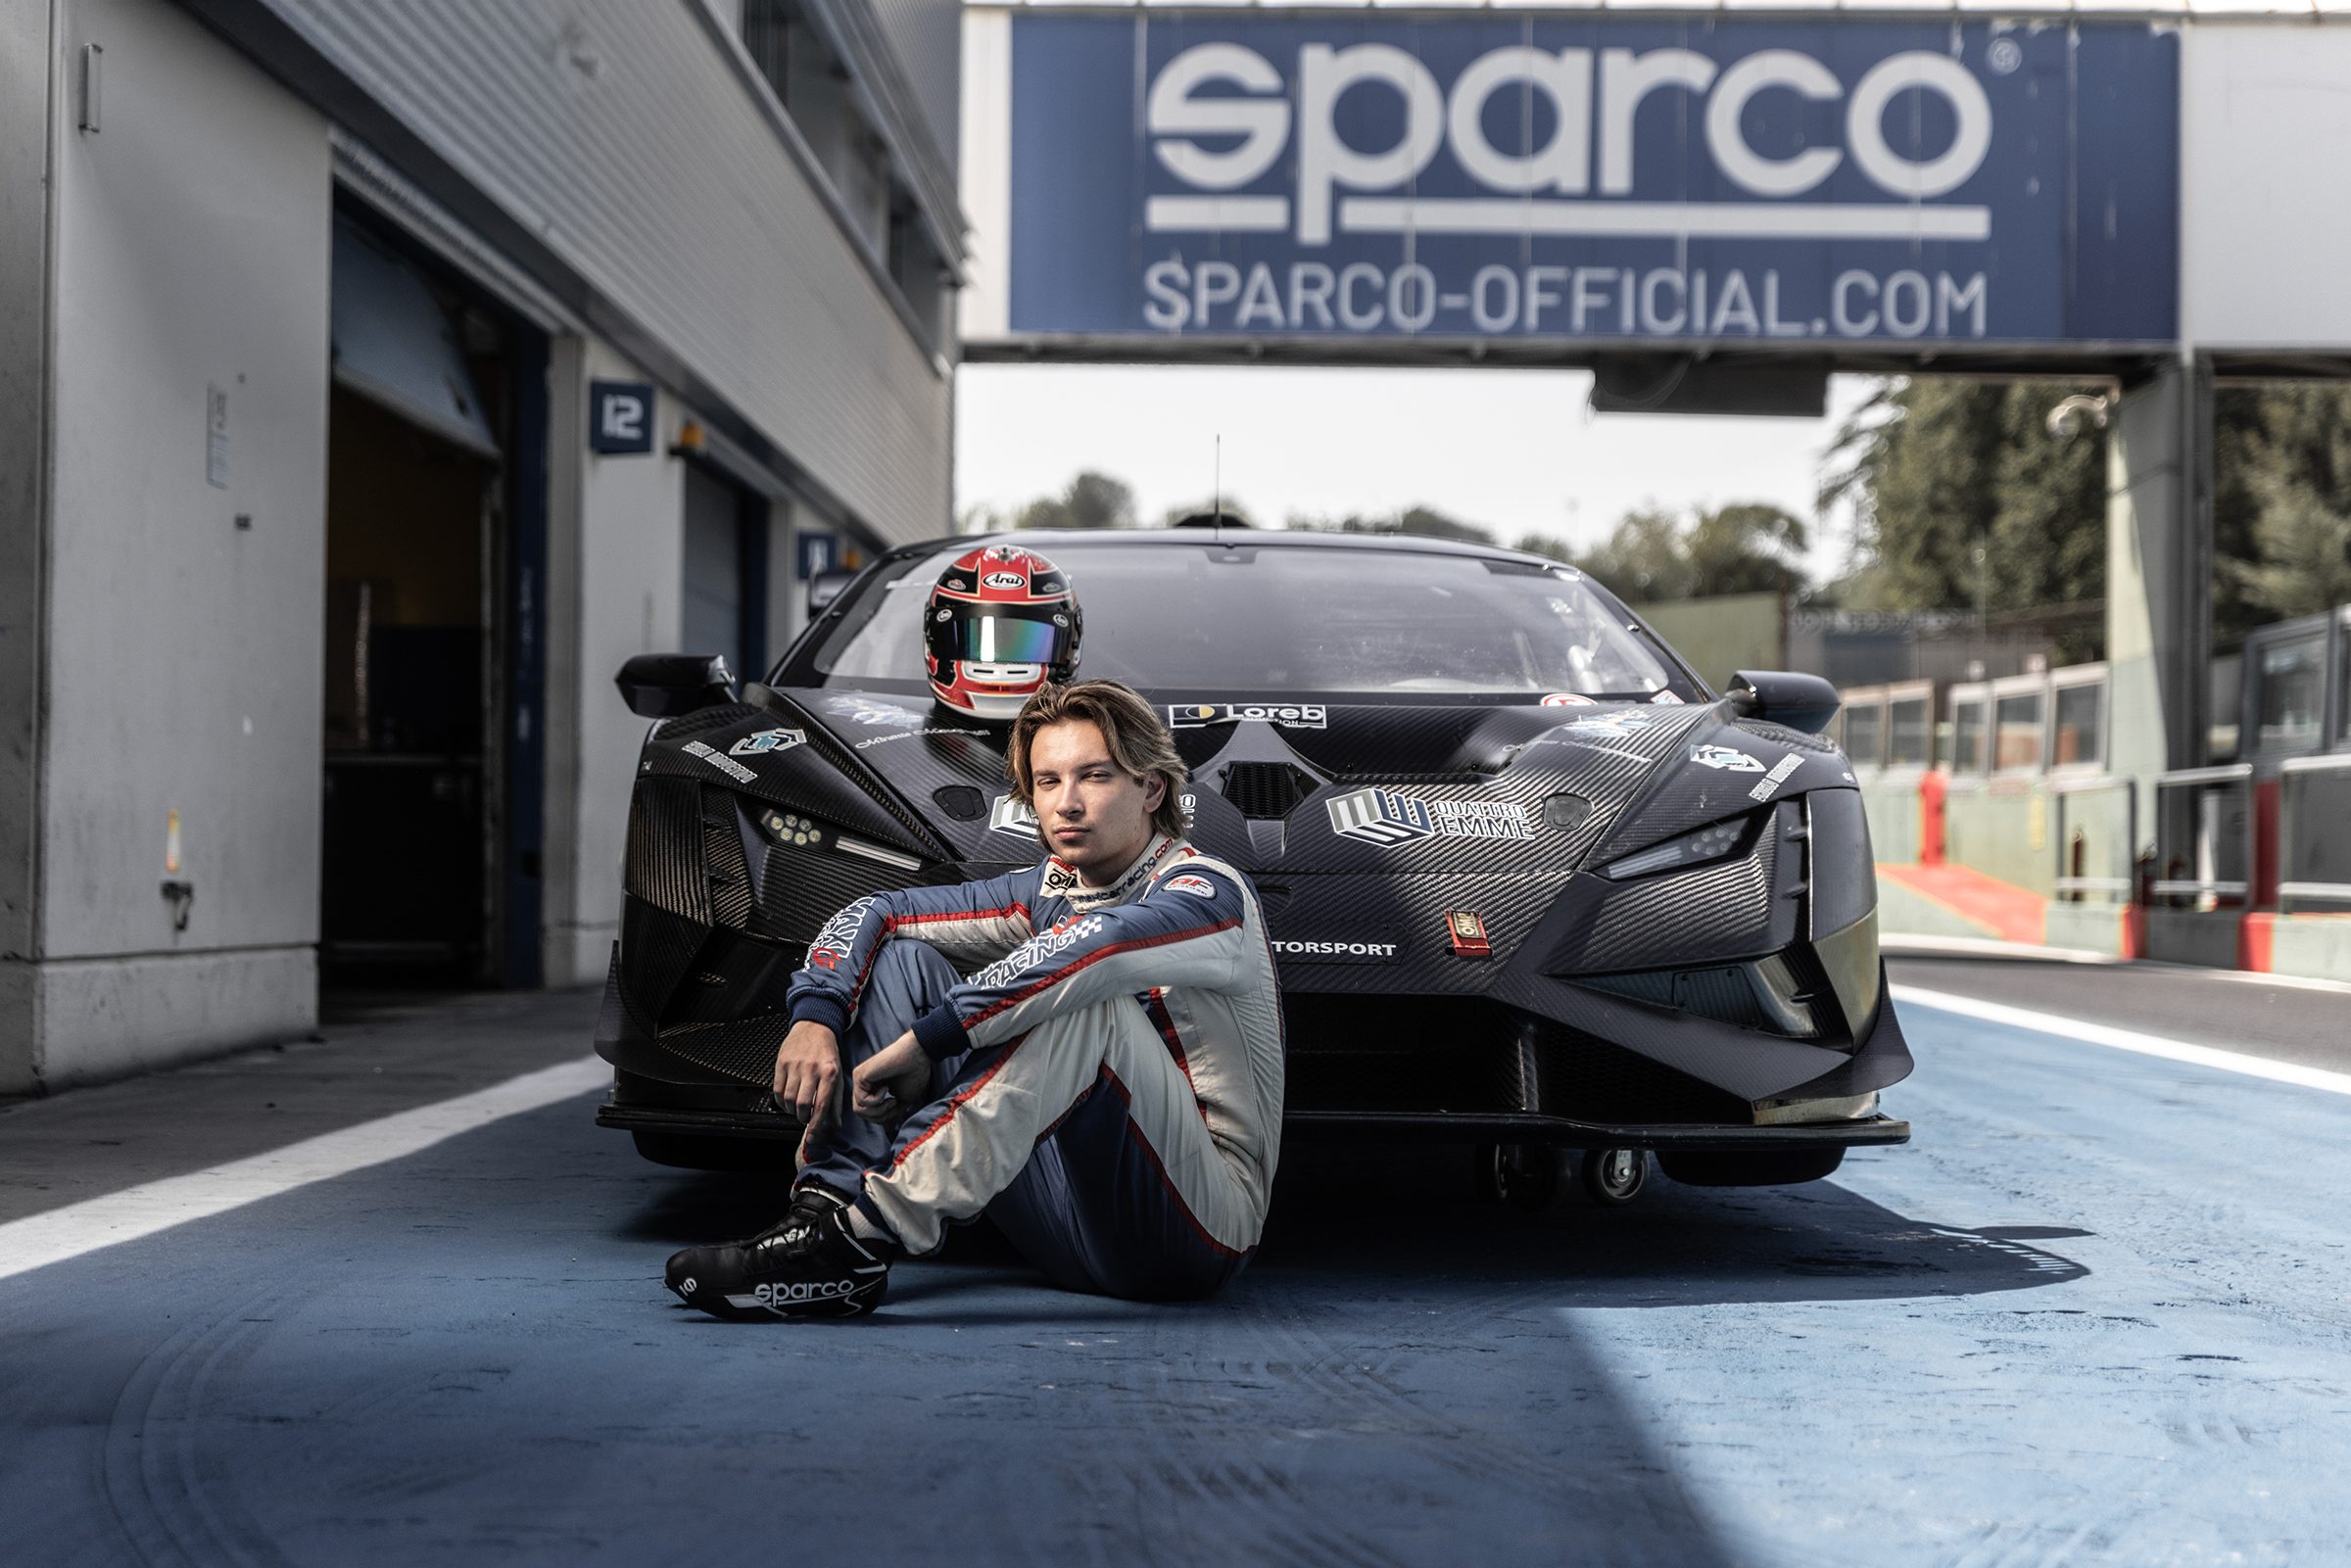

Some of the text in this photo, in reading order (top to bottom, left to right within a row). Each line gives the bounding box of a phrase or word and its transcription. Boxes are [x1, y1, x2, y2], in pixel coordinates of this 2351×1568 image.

[1147, 42, 1994, 245] sparco
[1143, 260, 1988, 338] SPARCO-OFFICIAL.COM
[602, 394, 644, 439] 12
[986, 573, 1020, 585] Arai
[1226, 704, 1324, 721] Loreb
[1433, 800, 1528, 819] QUATTRO
[1439, 816, 1536, 841] EMME
[754, 1279, 854, 1307] sparco
